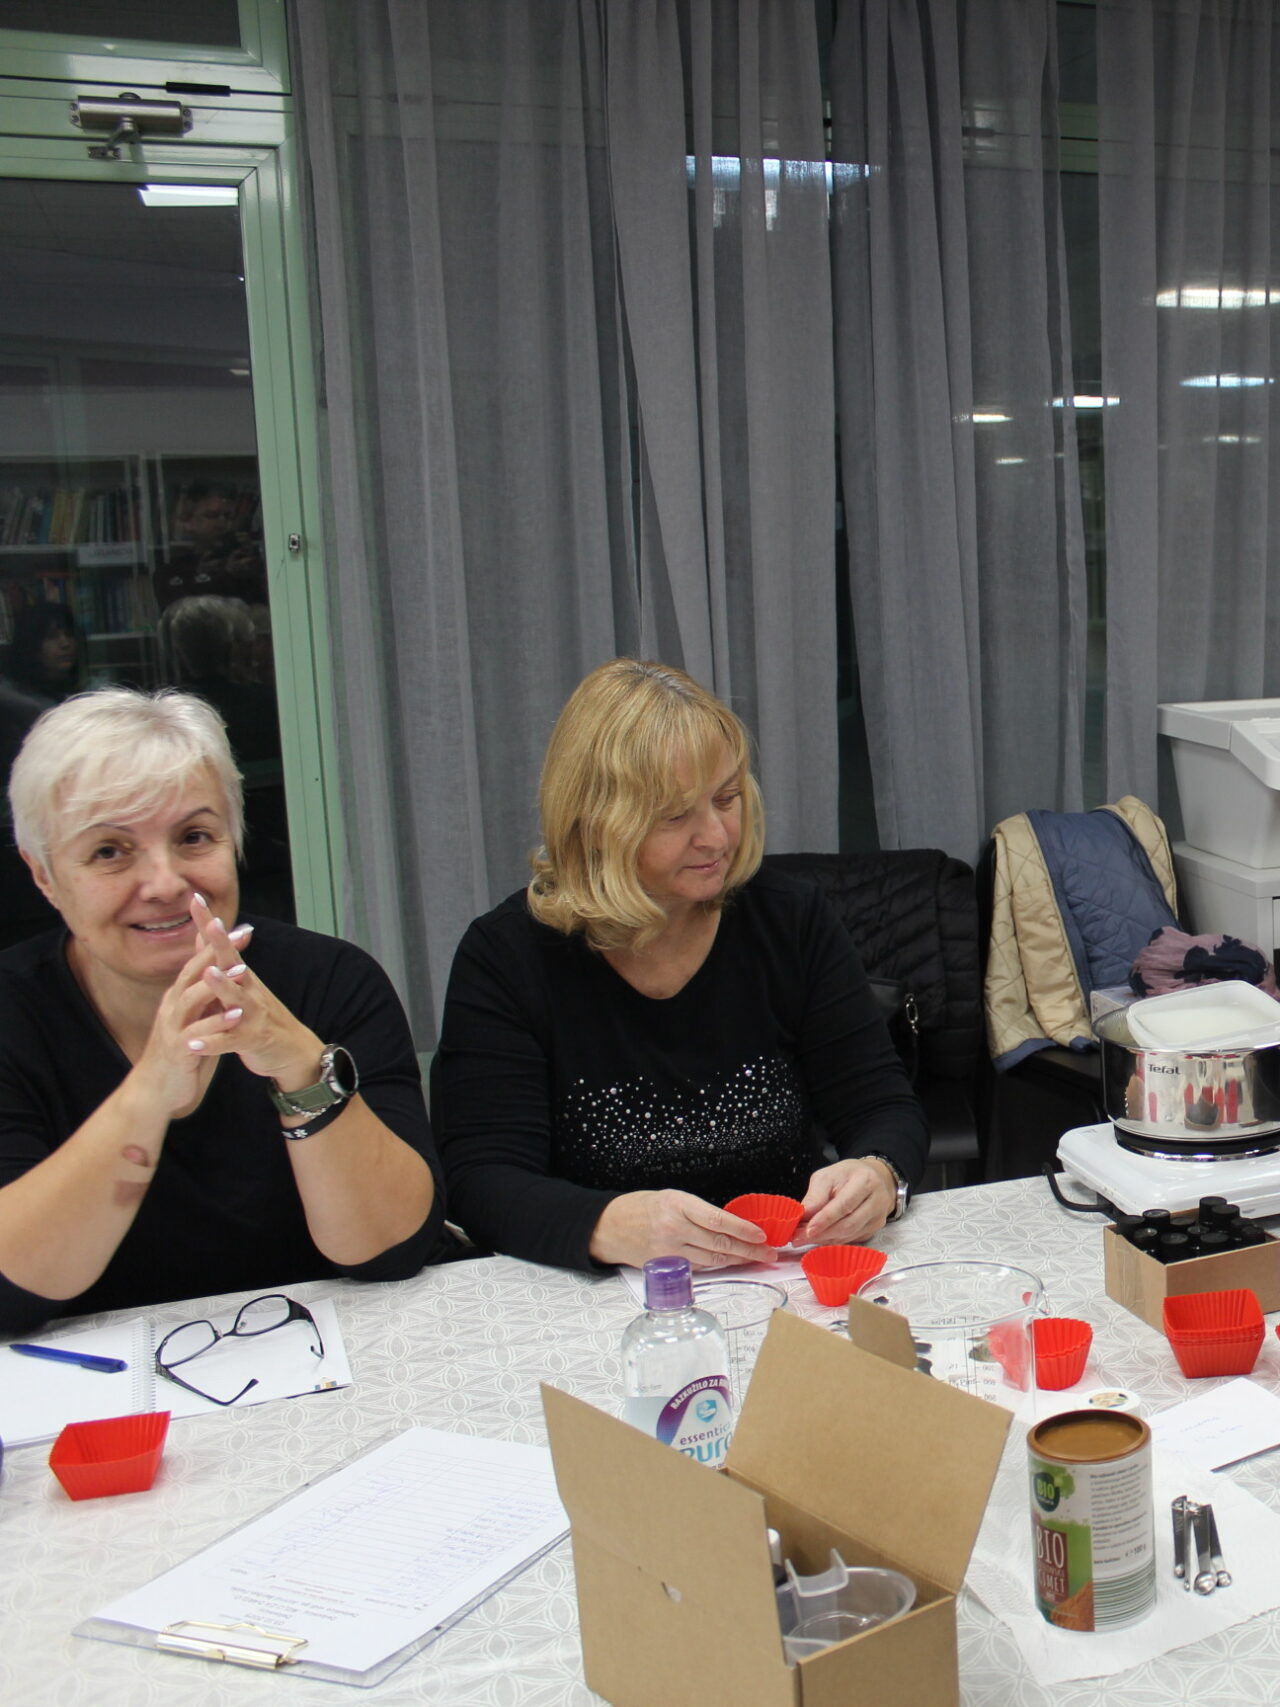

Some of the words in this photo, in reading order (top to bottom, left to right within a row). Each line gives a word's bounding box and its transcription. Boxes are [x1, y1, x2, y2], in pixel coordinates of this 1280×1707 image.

[1148, 1062, 1182, 1076] Tefal
[670, 1380, 708, 1410] RAZKUŽILO
[708, 1379, 719, 1388] ZA
[1036, 1480, 1055, 1499] BIO
[1036, 1526, 1065, 1568] BIO
[1038, 1569, 1065, 1593] CIMET
